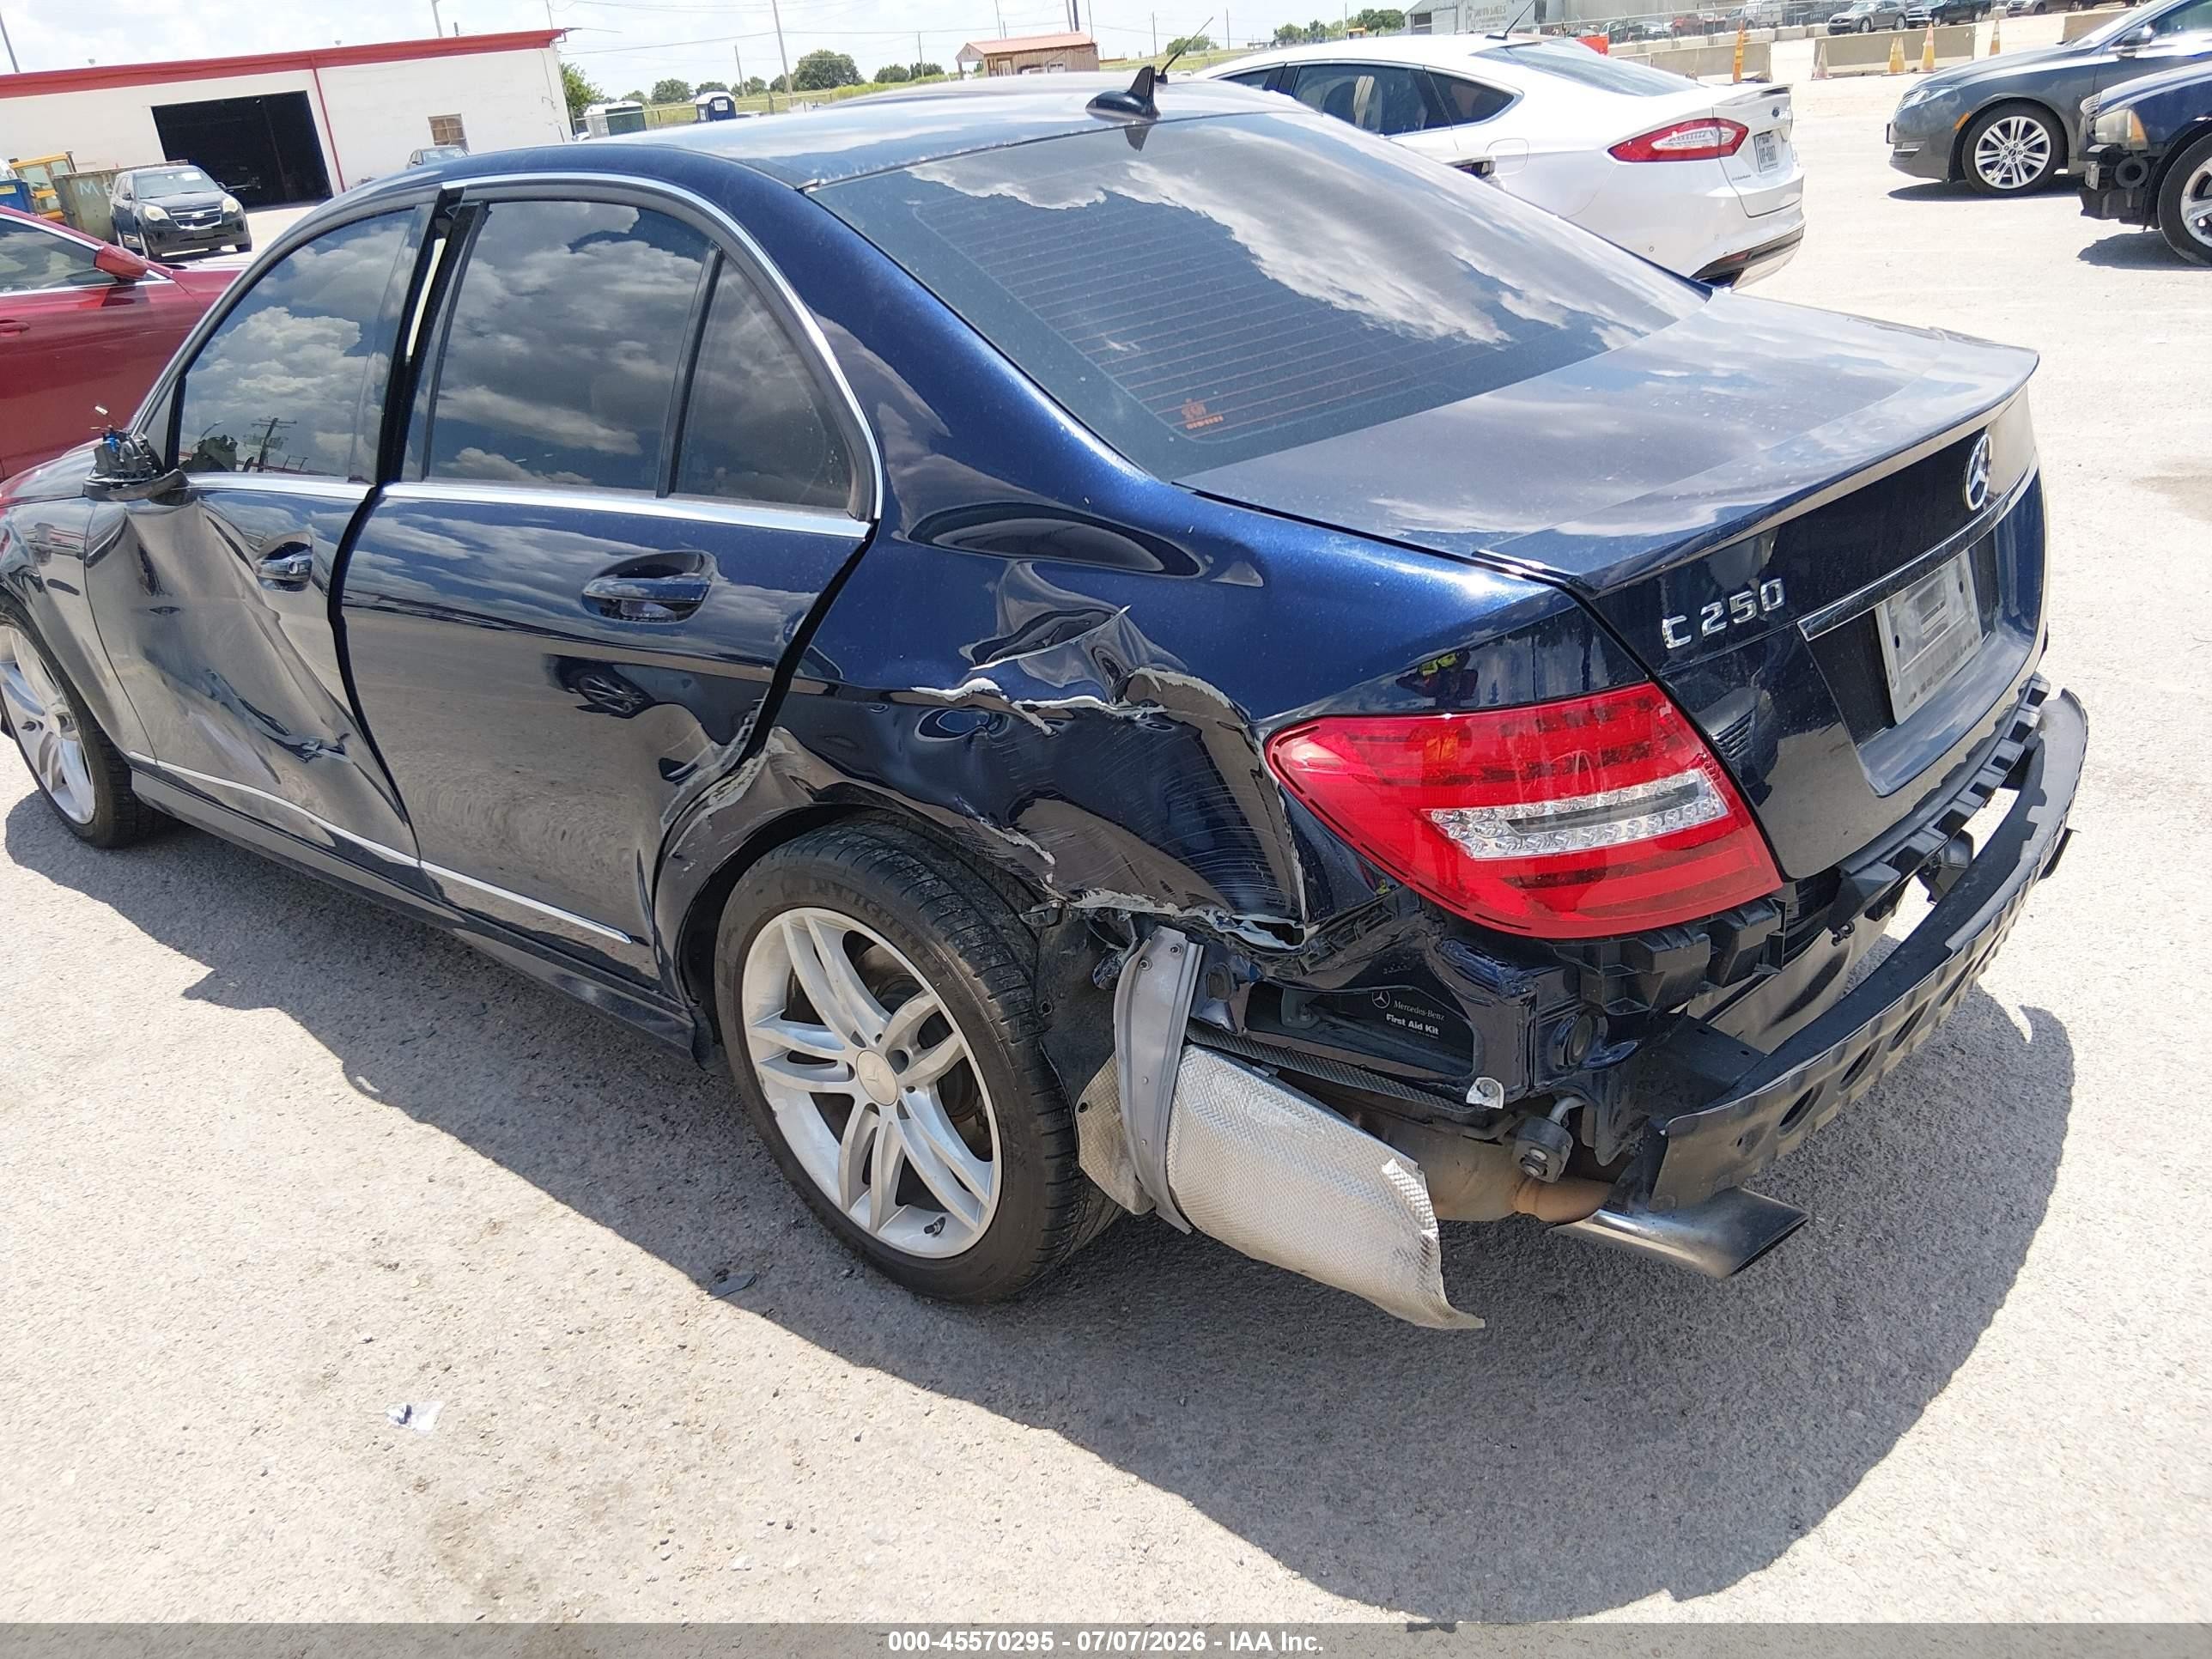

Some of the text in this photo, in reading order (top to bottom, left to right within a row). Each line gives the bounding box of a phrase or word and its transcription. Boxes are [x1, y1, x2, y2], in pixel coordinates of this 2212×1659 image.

[1662, 577, 1785, 649] C 250
[1393, 1000, 1446, 1021] Mercedes-Benz
[1386, 1013, 1407, 1026] First
[1408, 1020, 1423, 1030] Aid
[1425, 1024, 1439, 1036] Kit
